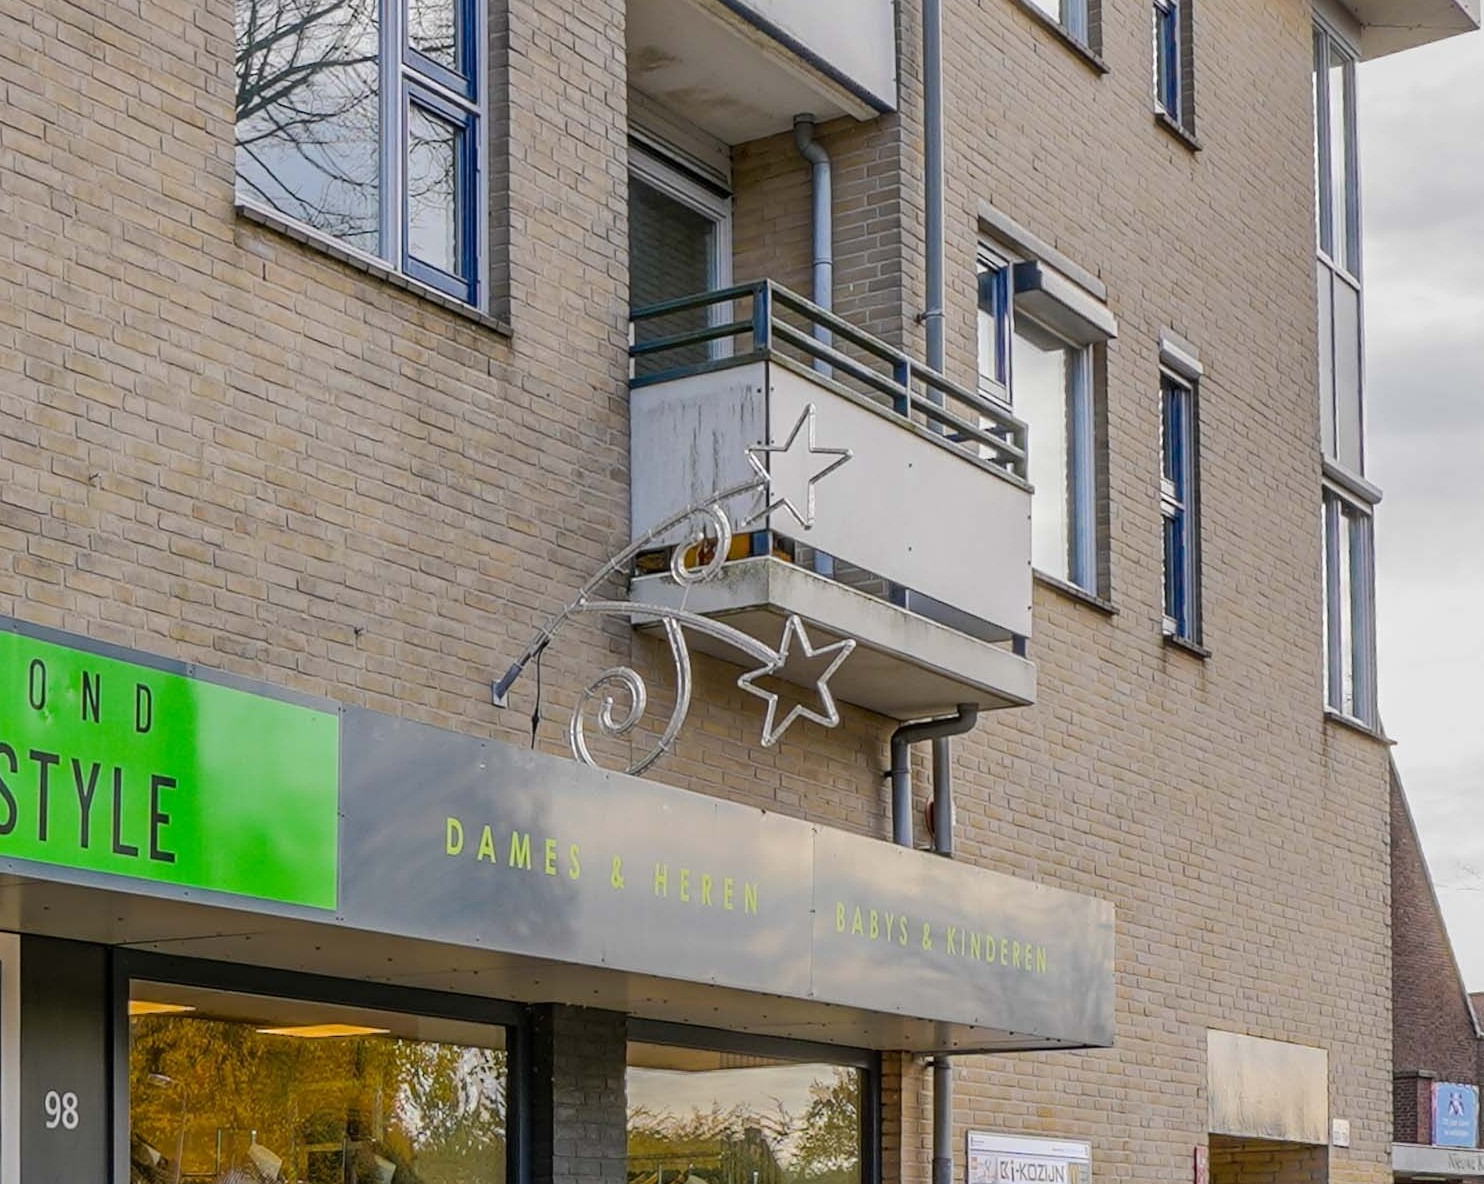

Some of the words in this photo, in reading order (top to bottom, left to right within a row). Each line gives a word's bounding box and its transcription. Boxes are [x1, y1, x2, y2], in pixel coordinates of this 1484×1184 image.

[445, 816, 583, 881] DAMES
[610, 856, 626, 890] &
[653, 863, 761, 915] HEREN
[835, 901, 910, 946] BABYS
[922, 921, 934, 951] &
[946, 926, 1049, 974] KINDEREN
[44, 1090, 80, 1130] 98
